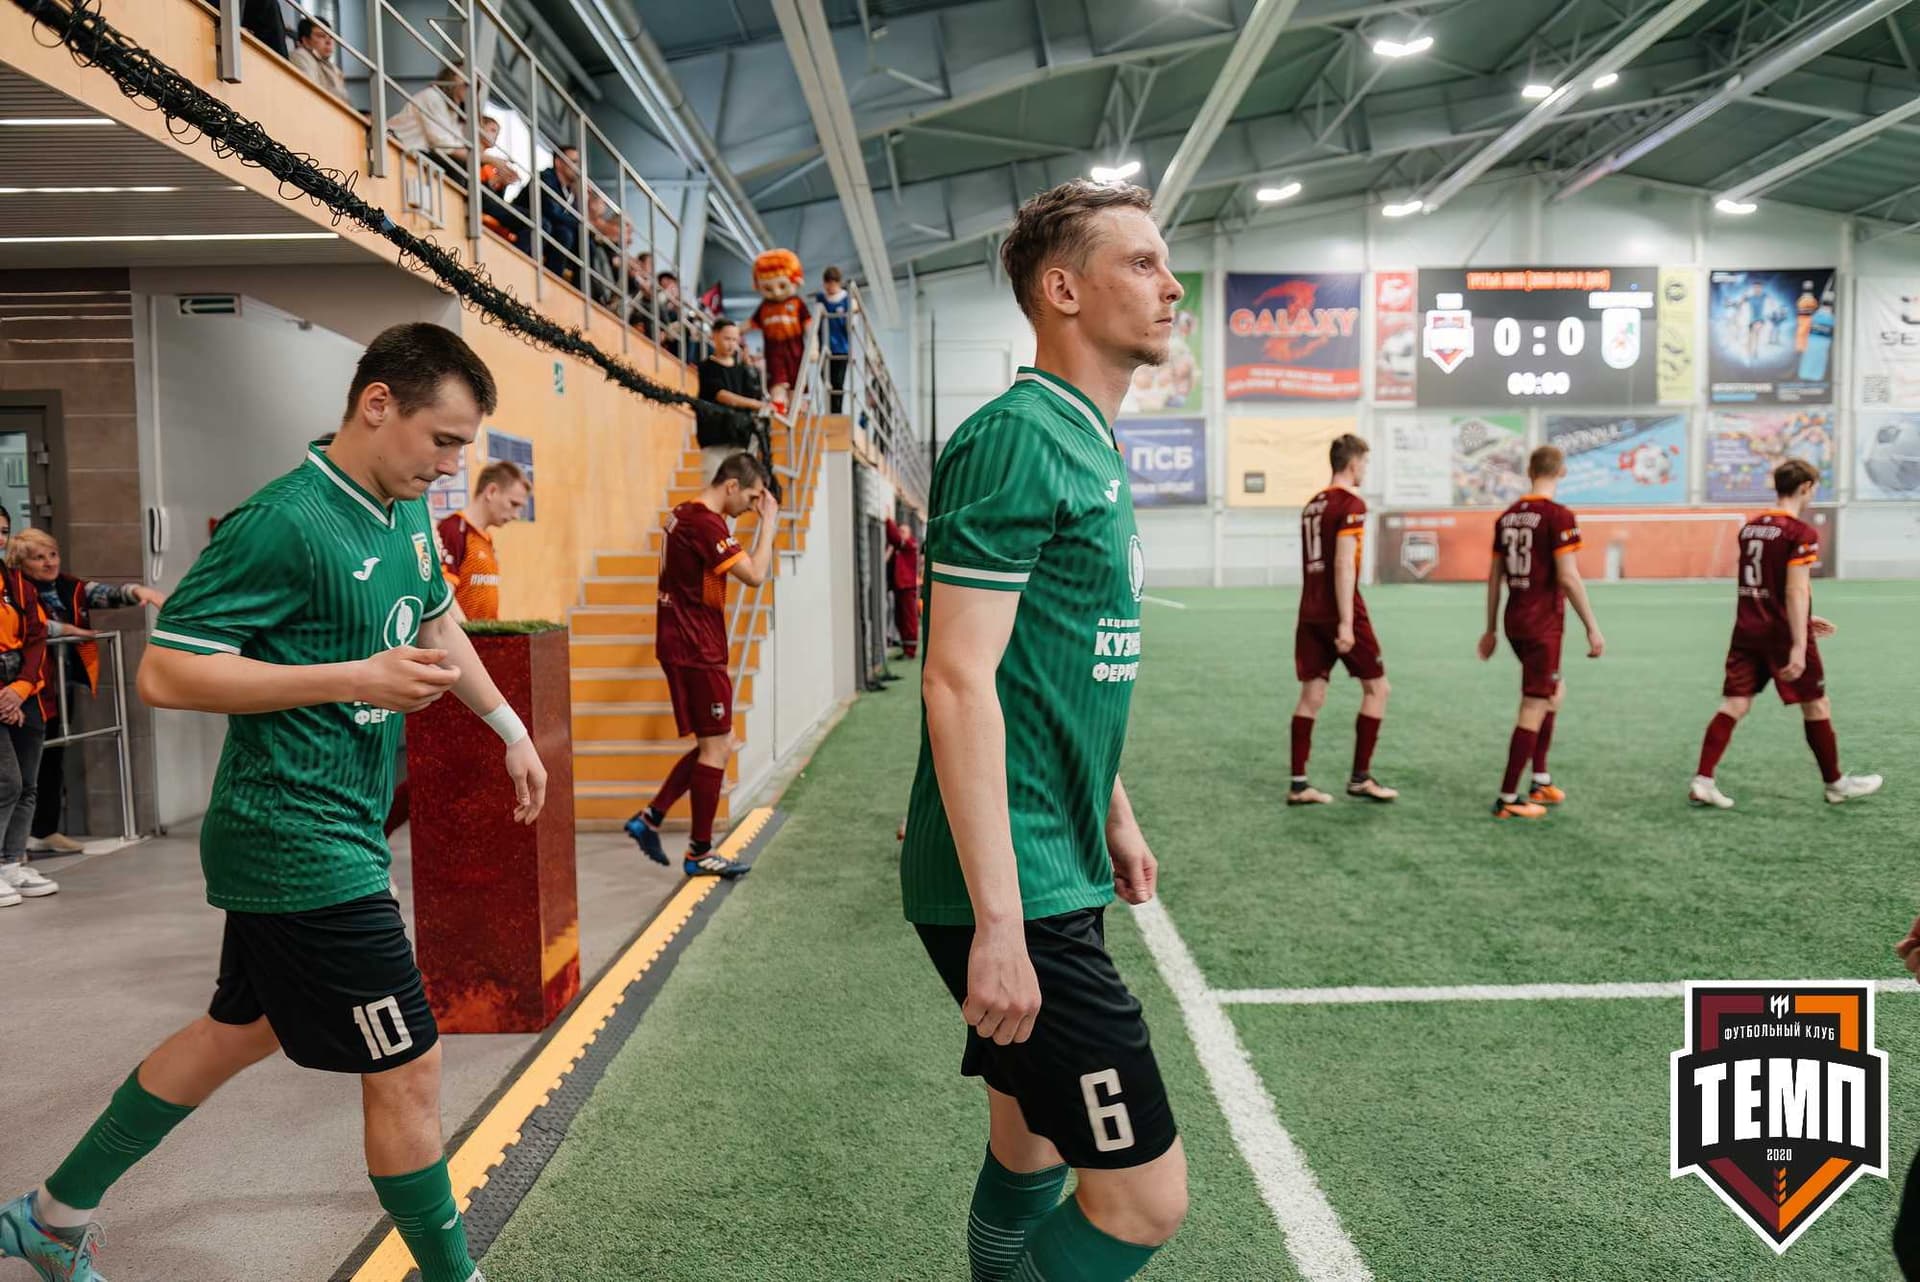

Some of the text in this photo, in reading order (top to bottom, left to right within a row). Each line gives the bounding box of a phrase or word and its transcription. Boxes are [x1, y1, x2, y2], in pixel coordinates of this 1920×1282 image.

[1229, 307, 1359, 336] GALAXY
[1131, 446, 1193, 471] ПСБ
[1502, 527, 1533, 576] 33
[1744, 540, 1764, 587] 3
[354, 708, 397, 725] ФЕР
[353, 995, 413, 1060] 10
[1080, 1068, 1135, 1152] 6
